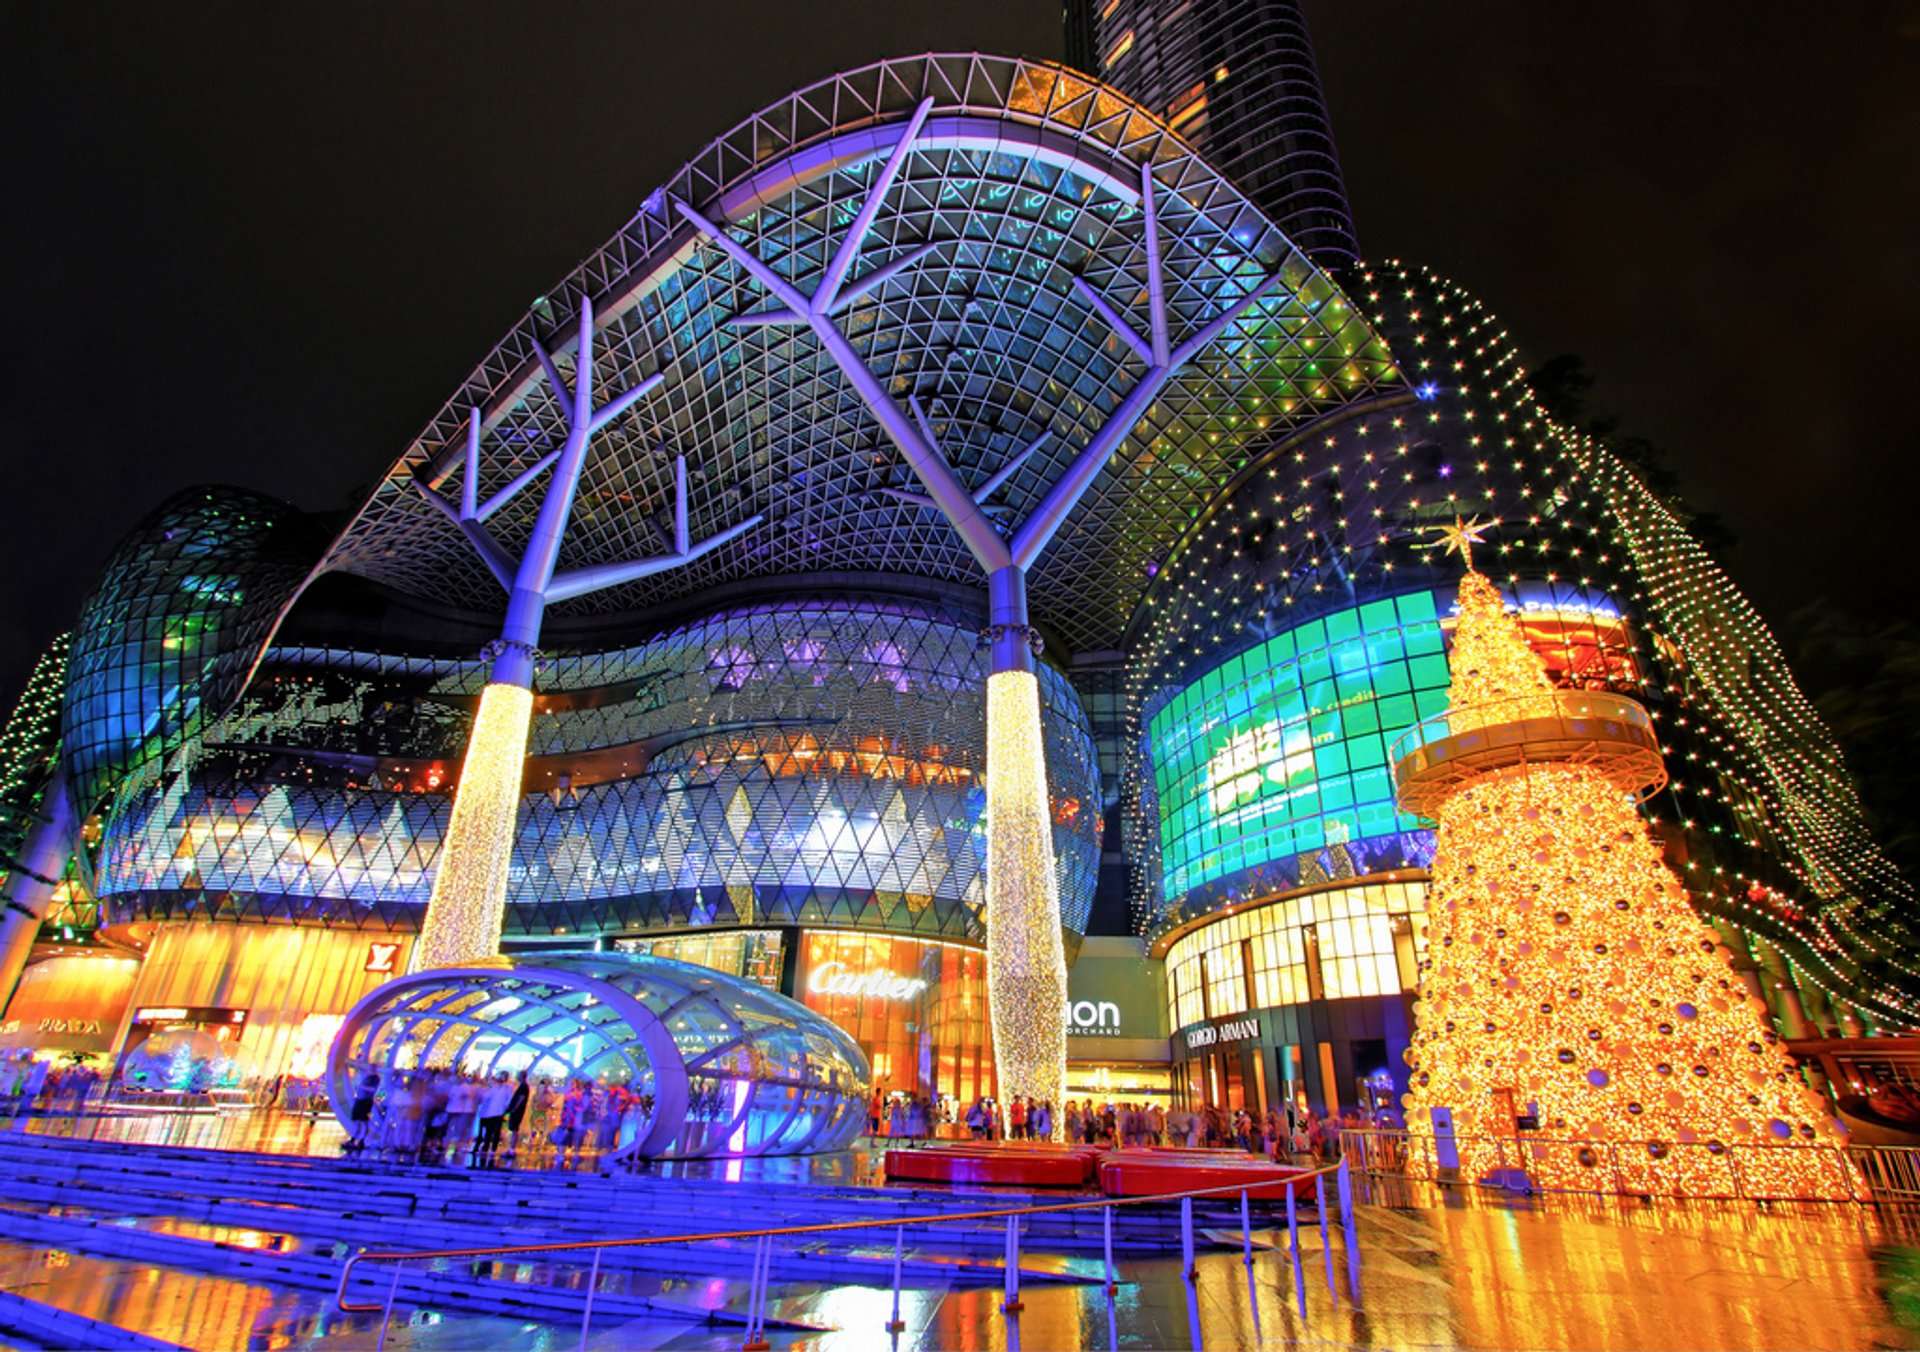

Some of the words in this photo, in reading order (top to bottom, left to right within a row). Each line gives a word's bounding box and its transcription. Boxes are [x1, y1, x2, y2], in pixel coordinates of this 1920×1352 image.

[808, 961, 928, 1001] Cartier
[37, 1018, 102, 1035] PRADA
[1065, 1027, 1120, 1036] ORCHARD
[1219, 1019, 1258, 1041] ARMANI
